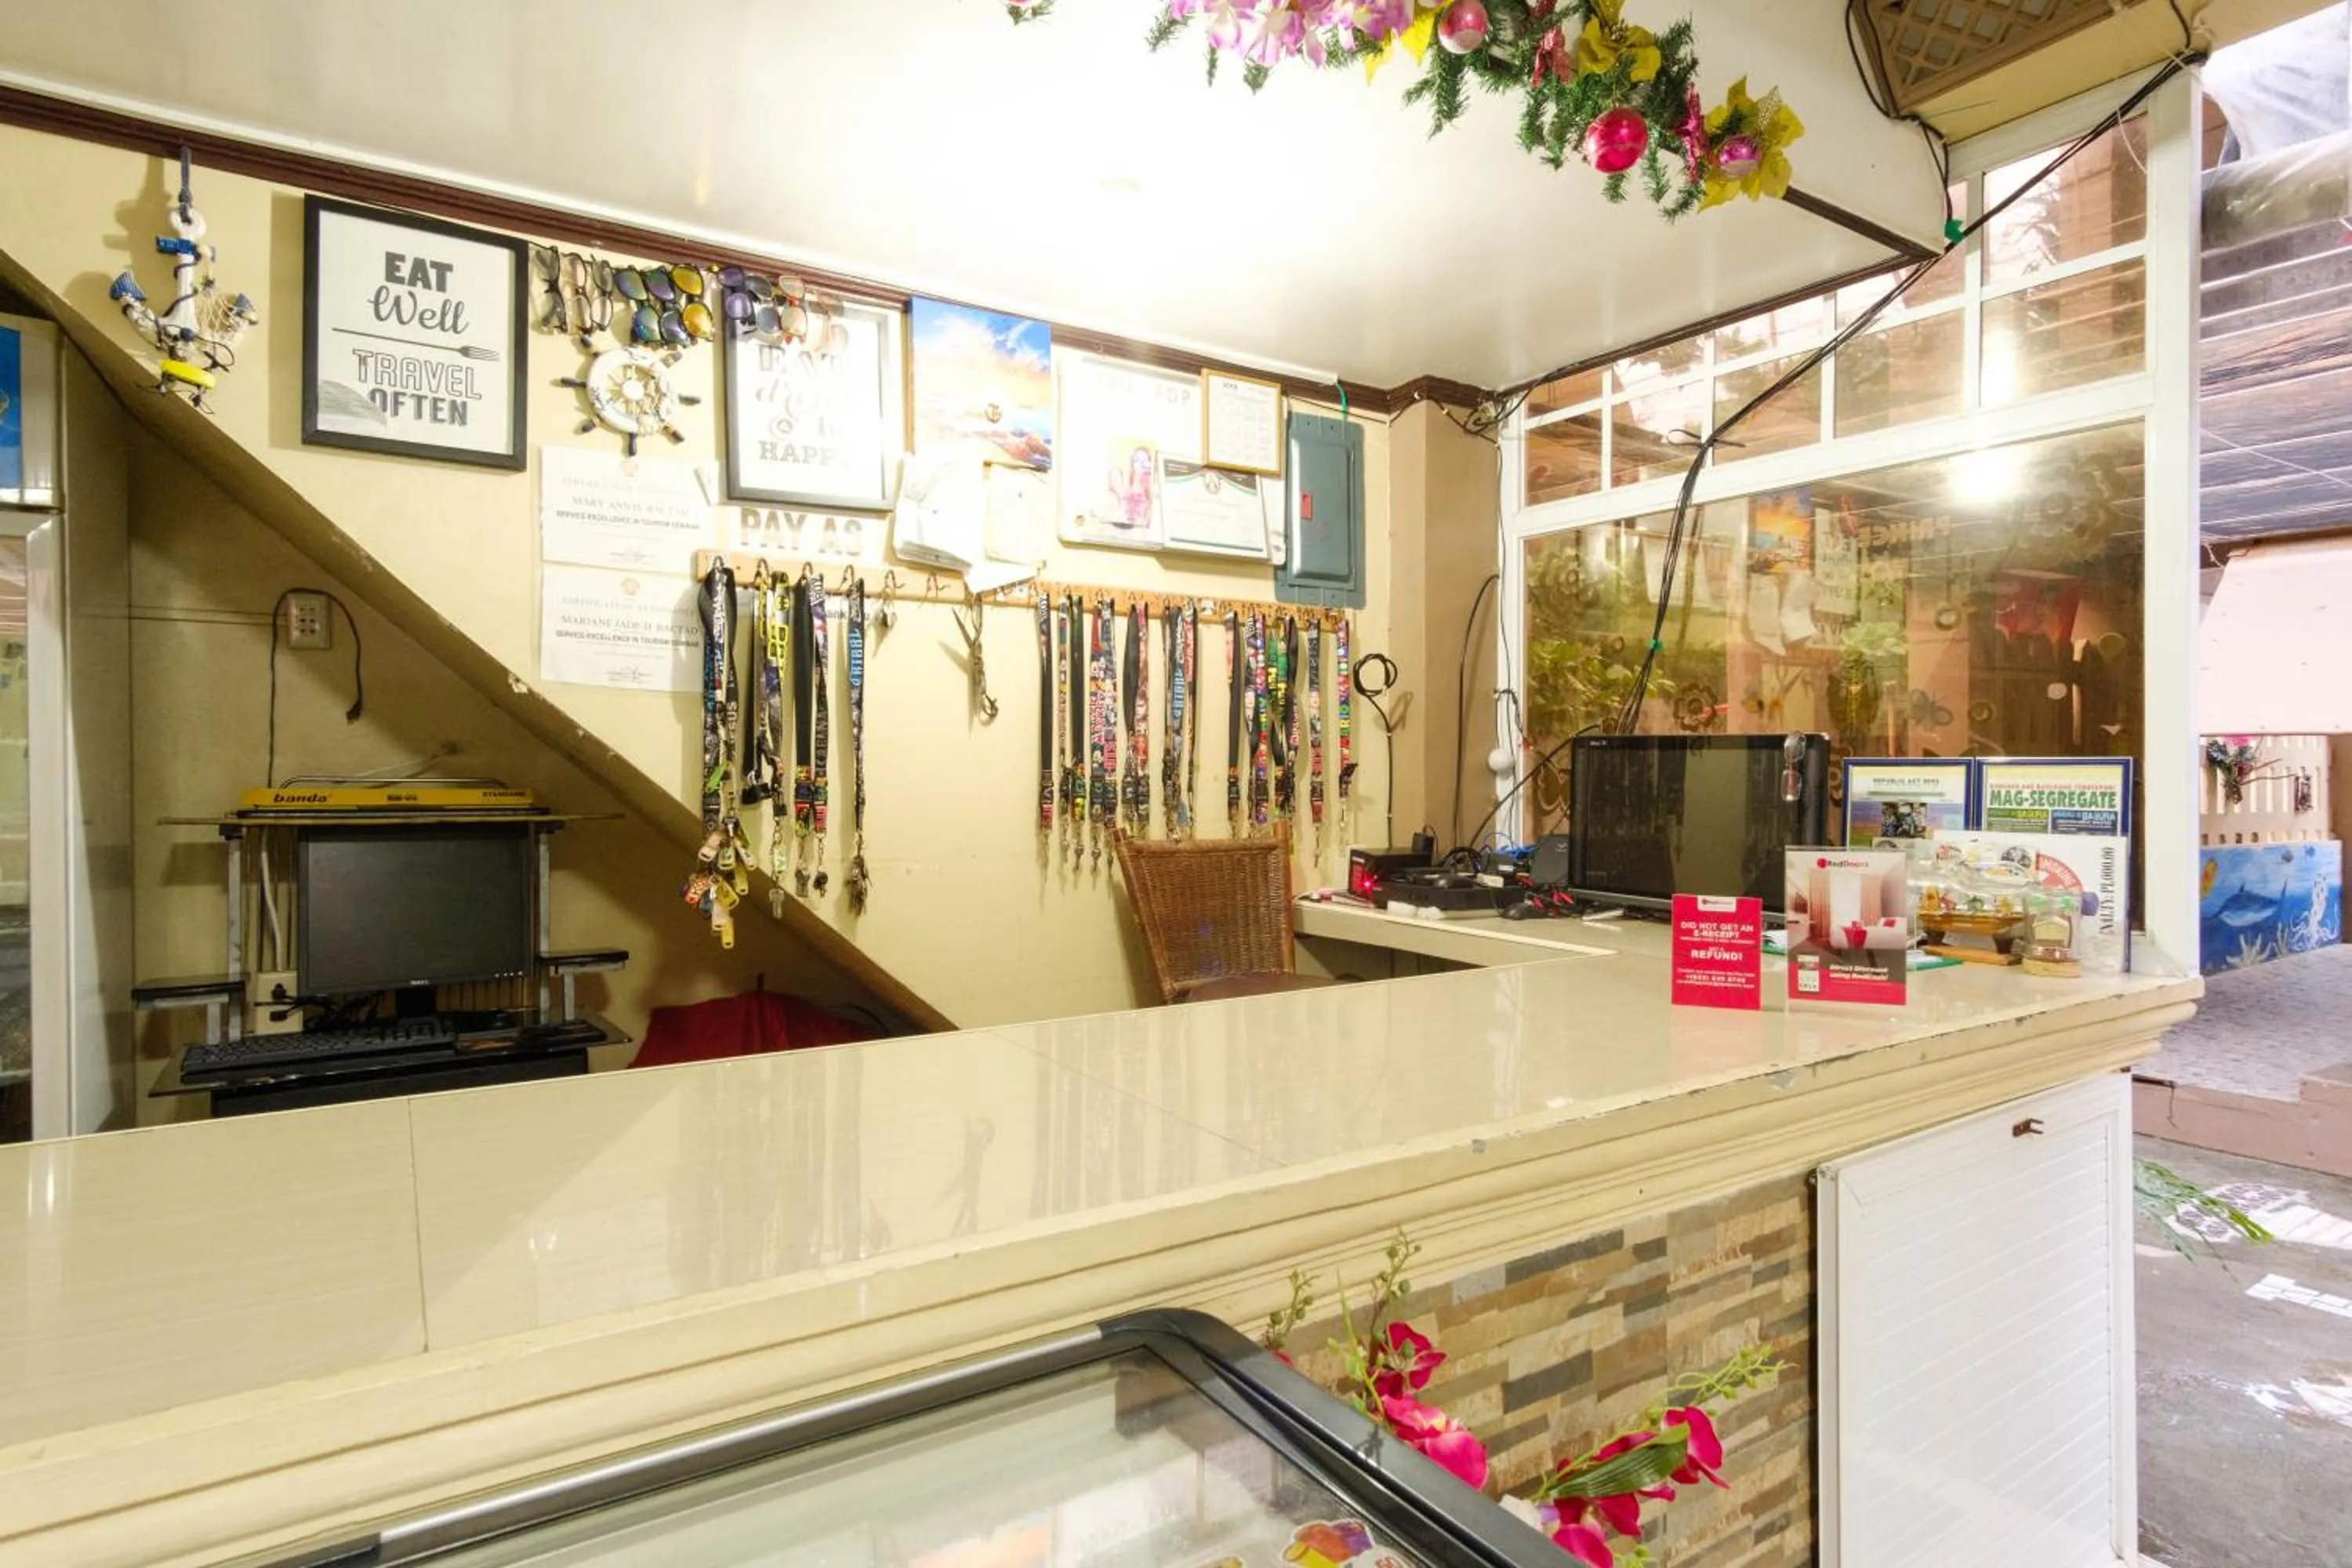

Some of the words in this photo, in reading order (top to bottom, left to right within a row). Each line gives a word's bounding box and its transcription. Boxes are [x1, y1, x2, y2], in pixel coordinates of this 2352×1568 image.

[385, 251, 453, 293] EAT
[367, 285, 470, 335] Well
[352, 348, 482, 401] TRAVEL
[1990, 789, 2117, 808] MAG-SEGREGATE
[1691, 949, 1743, 960] REFUND!
